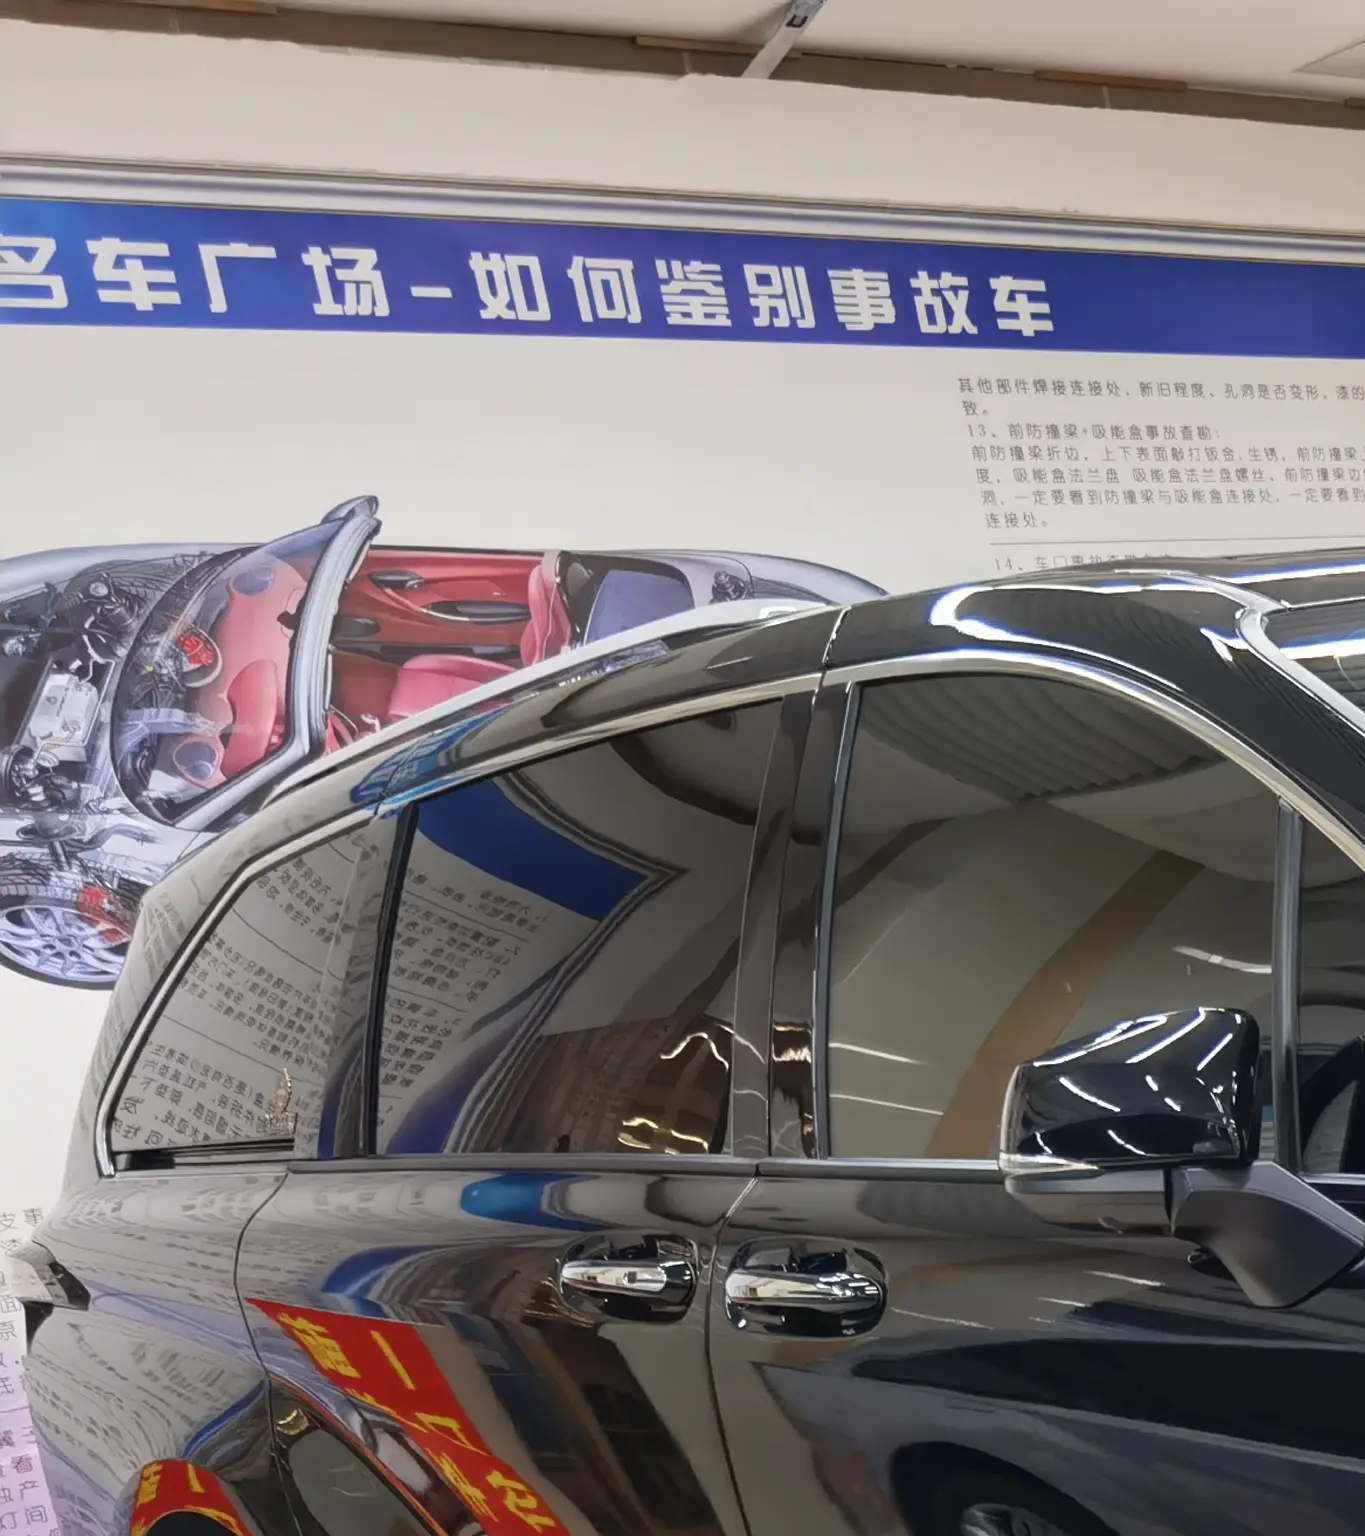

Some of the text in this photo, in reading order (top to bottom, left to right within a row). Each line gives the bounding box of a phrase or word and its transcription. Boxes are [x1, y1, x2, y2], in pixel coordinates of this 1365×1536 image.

[0, 234, 1054, 338] 名车广场-如何鉴别事故车
